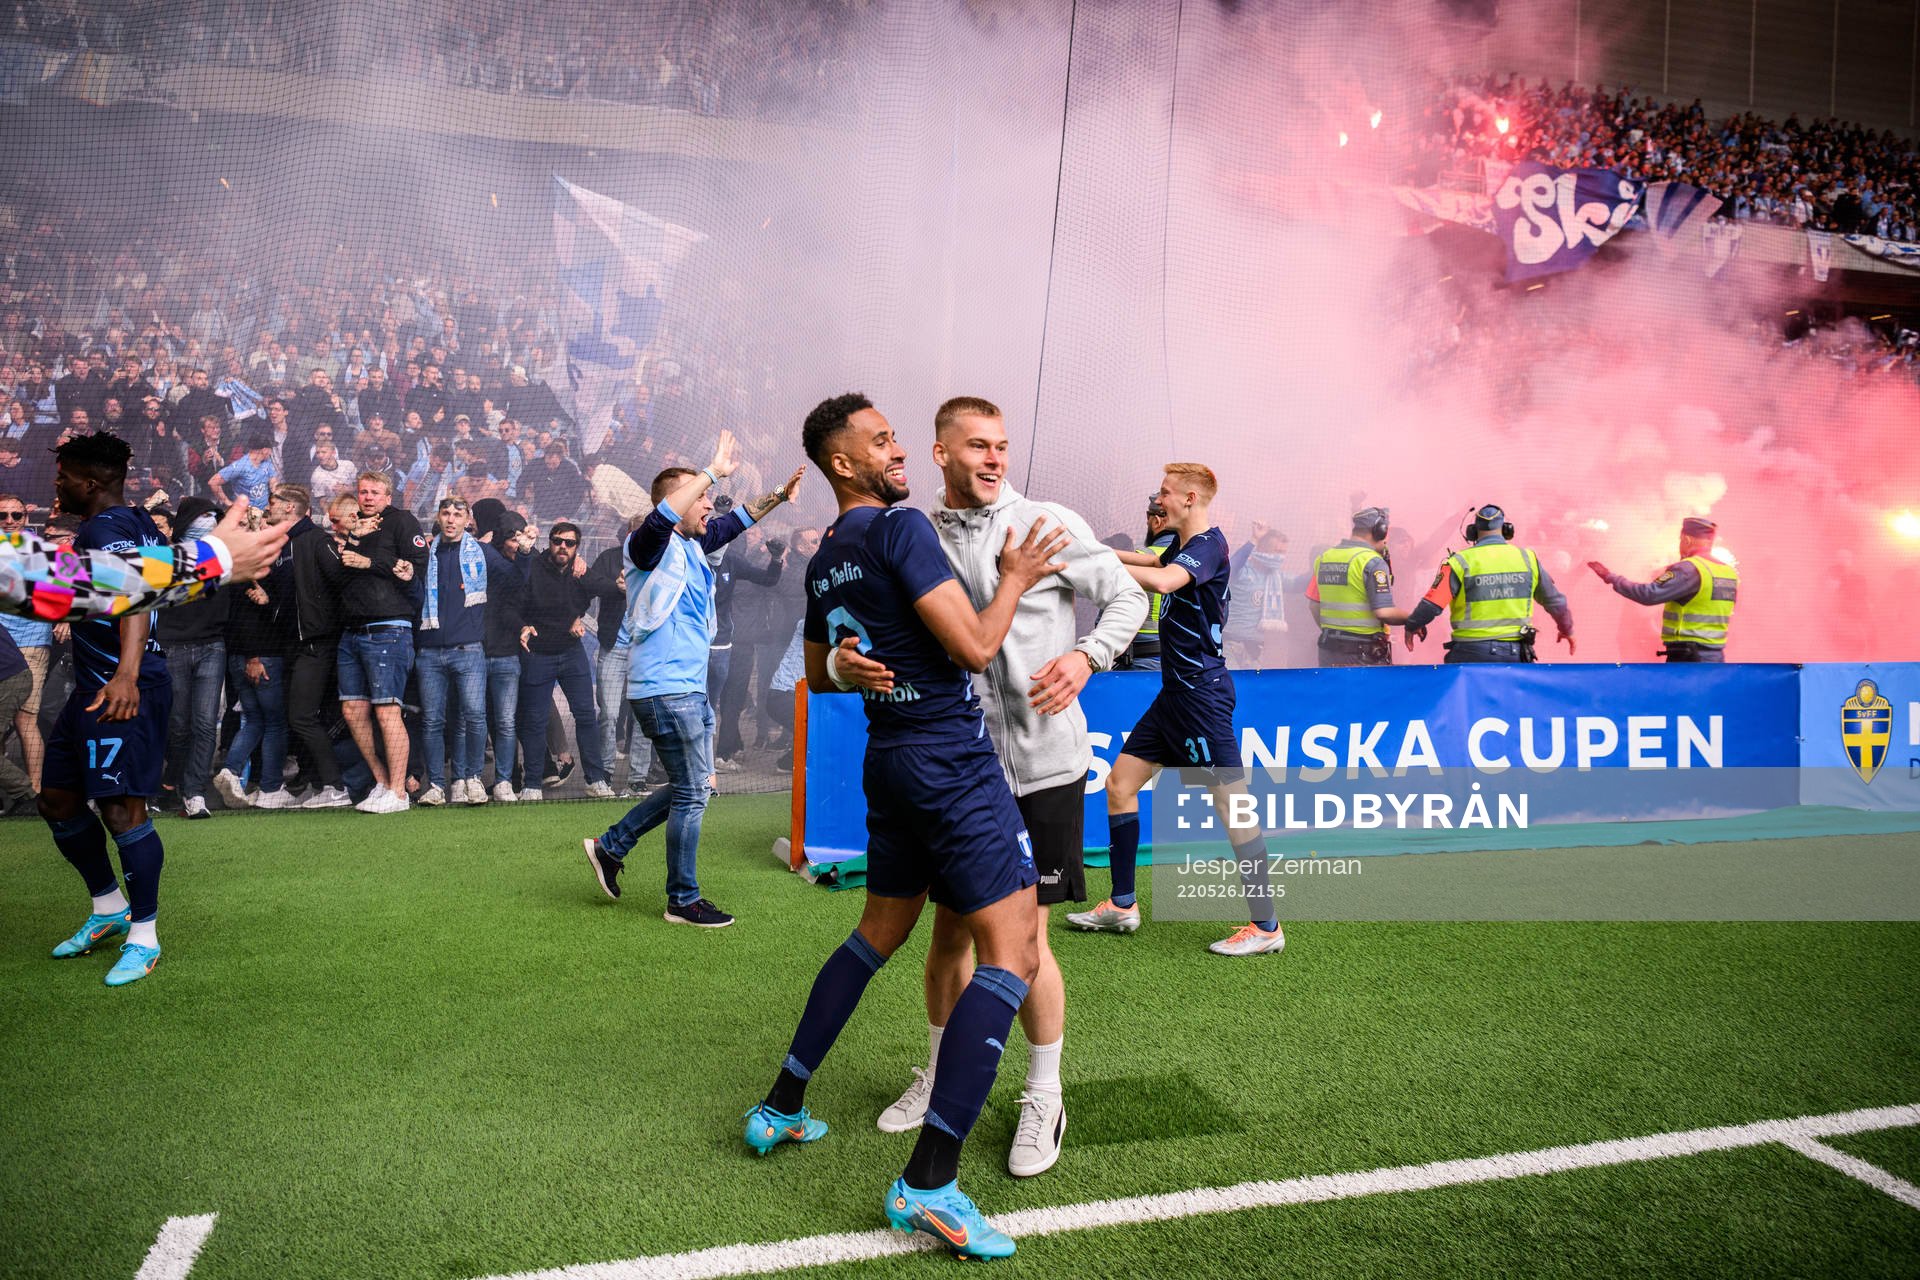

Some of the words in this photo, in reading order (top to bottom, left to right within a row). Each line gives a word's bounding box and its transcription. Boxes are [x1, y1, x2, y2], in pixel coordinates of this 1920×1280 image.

[1474, 573, 1526, 586] ORDNINGS
[1490, 588, 1515, 598] VAKT
[1857, 710, 1877, 718] SvFF
[87, 738, 122, 769] 17
[1084, 719, 1444, 794] SNSKA
[1468, 715, 1723, 774] CUPEN
[1185, 736, 1211, 764] 31
